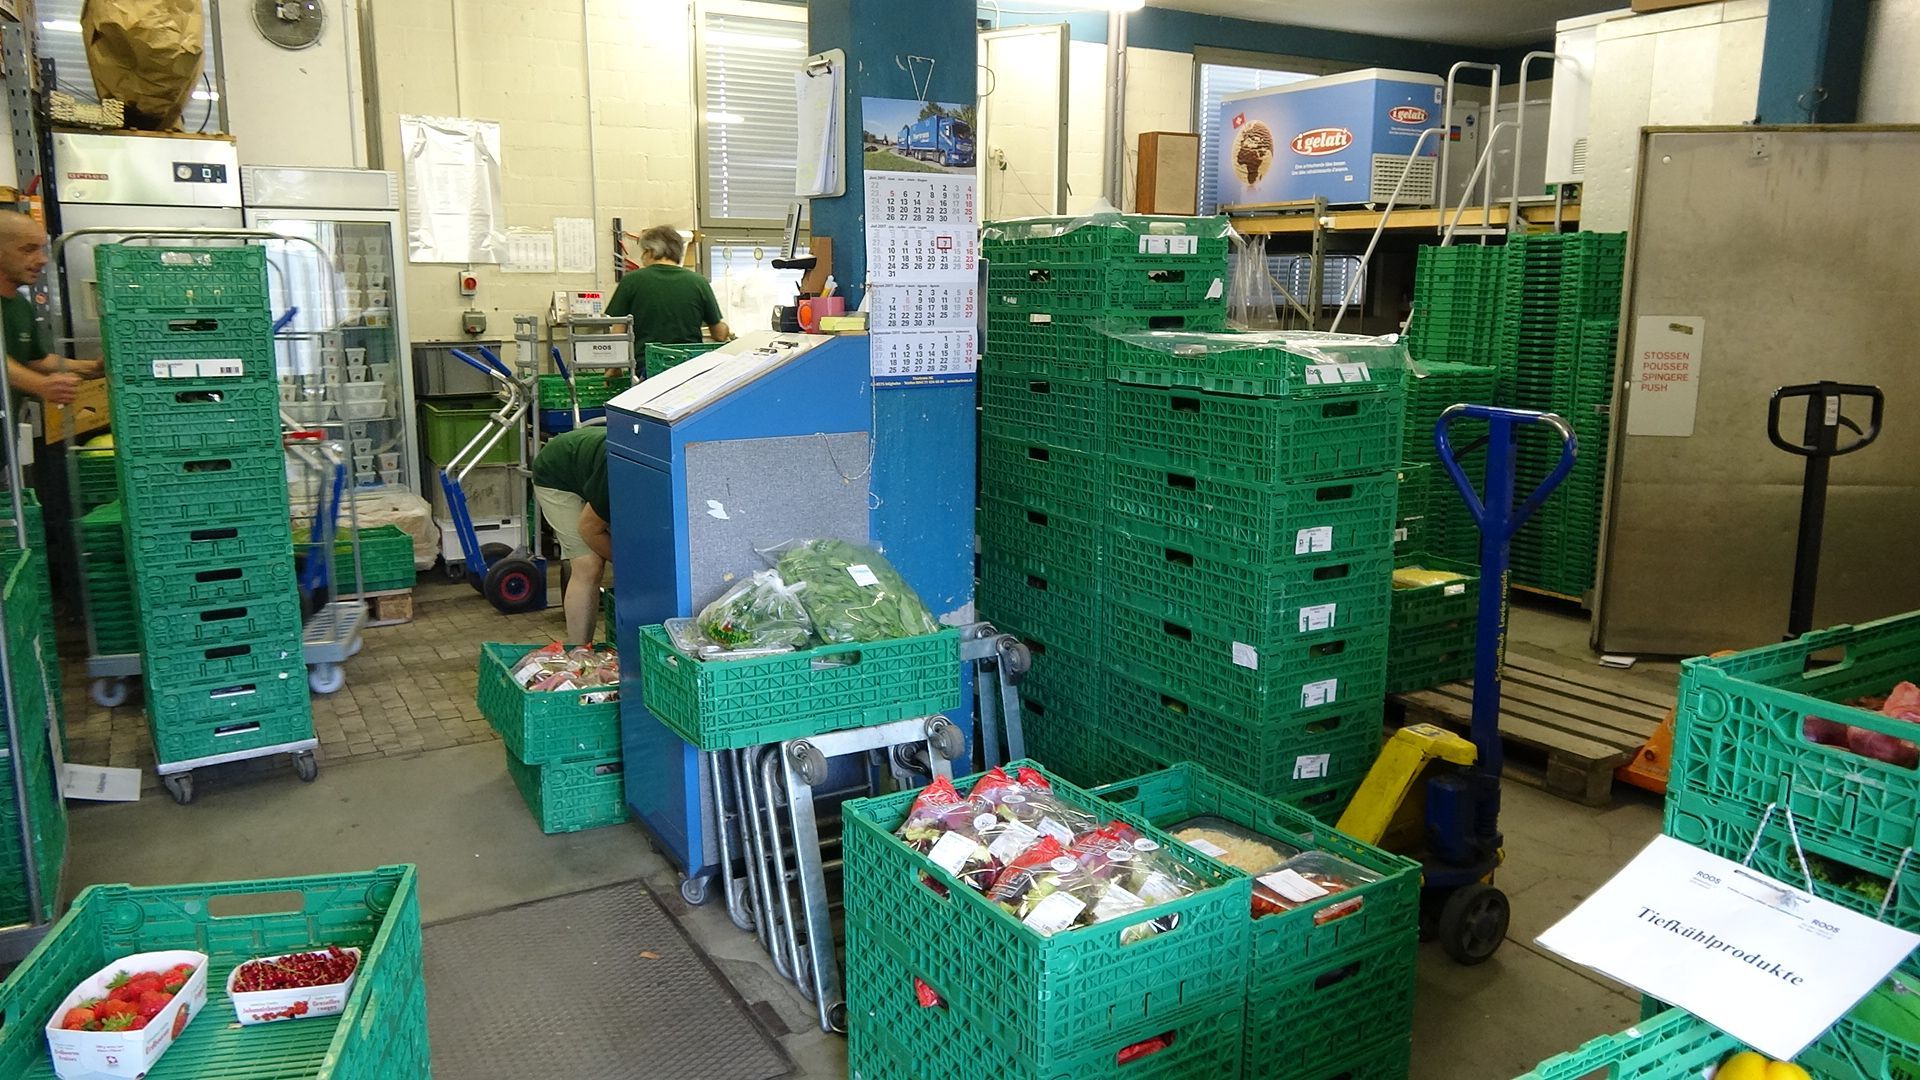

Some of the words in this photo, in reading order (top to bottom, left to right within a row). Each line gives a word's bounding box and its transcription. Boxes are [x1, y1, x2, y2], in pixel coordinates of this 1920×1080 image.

[1398, 109, 1425, 120] gelati
[1296, 133, 1304, 150] i
[1304, 128, 1348, 154] gelati
[1642, 362, 1688, 370] POUSSER
[1642, 373, 1688, 381] SPINGERE
[1640, 384, 1668, 392] PUSH
[1696, 870, 1722, 885] ROOS
[1811, 918, 1840, 934] ROOS
[1637, 906, 1804, 986] Tiefkühlprodukte
